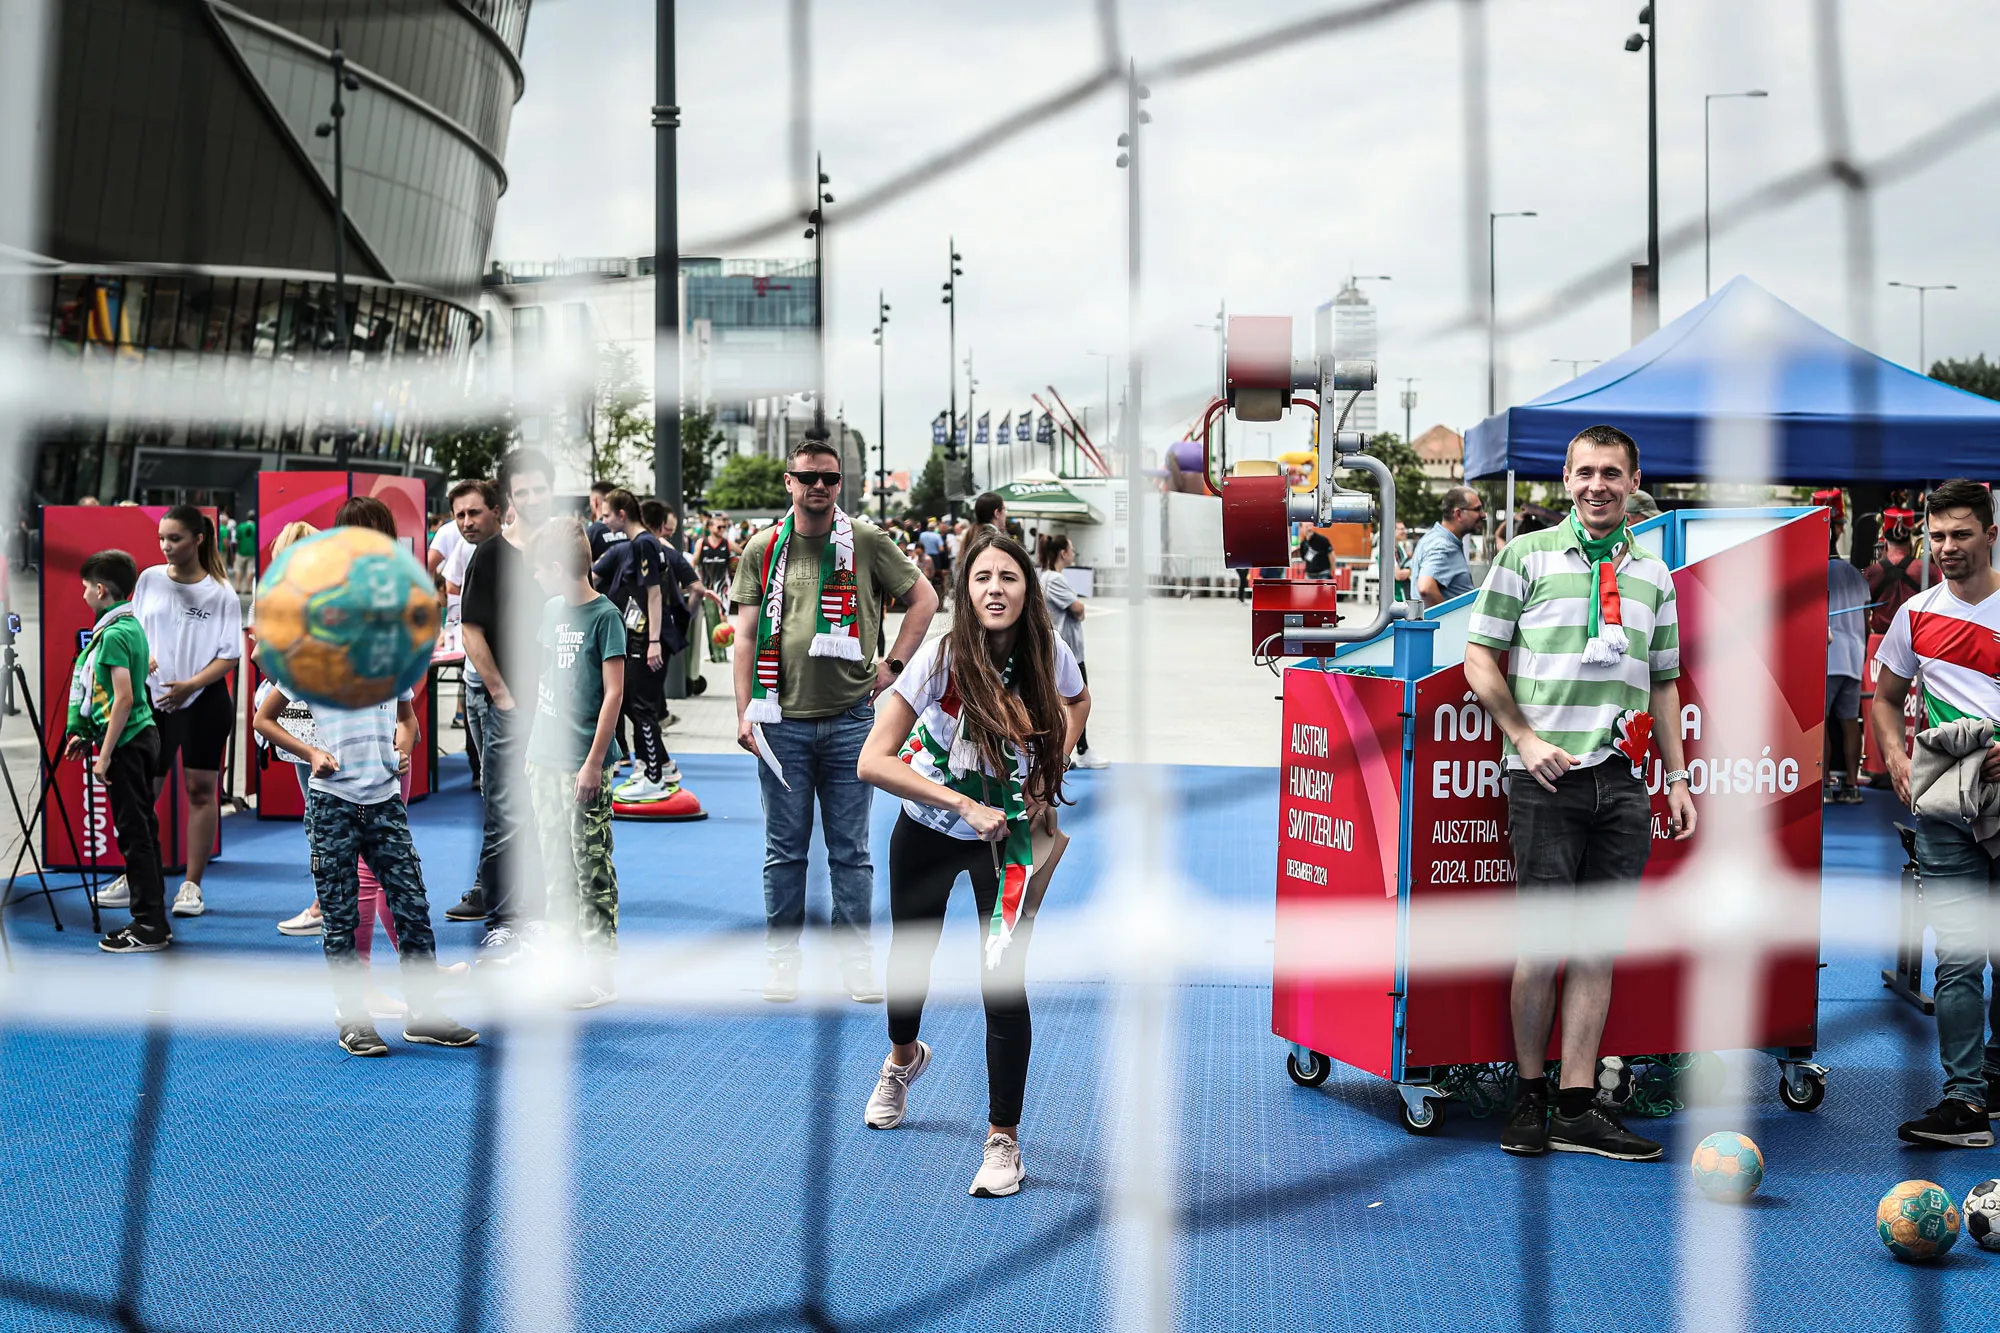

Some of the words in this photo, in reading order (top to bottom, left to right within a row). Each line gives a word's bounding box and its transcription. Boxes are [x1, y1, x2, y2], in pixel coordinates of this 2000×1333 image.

[558, 631, 585, 644] DUDE
[557, 652, 576, 668] UP
[1291, 723, 1329, 758] AUSTRIA
[1289, 765, 1334, 803] HUNGARY
[1287, 808, 1354, 852] SWITZERLAND
[1432, 820, 1499, 844] AUSZTRIA
[1286, 858, 1313, 882] DECEMBER
[1313, 866, 1328, 886] 2024
[1430, 860, 1470, 884] 2024.
[1474, 859, 1518, 883] DECEM
